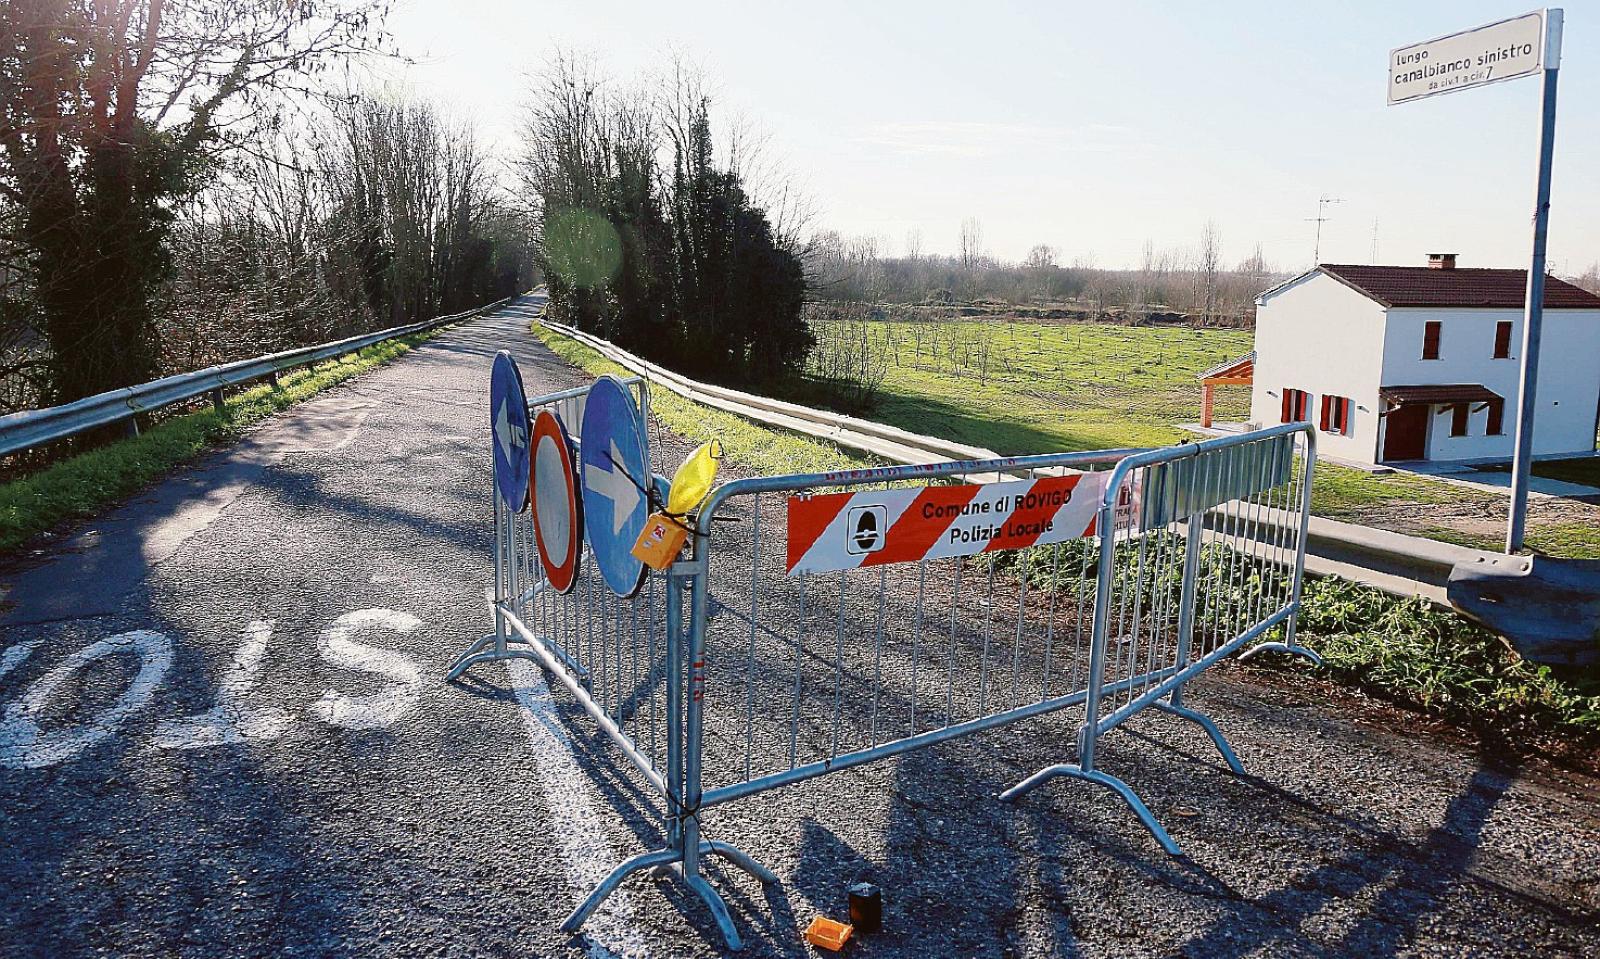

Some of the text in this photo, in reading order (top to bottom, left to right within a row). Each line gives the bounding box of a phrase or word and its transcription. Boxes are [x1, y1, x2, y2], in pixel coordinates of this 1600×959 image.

[1394, 43, 1532, 84] canalbianco sinistro
[1396, 50, 1429, 66] lungo
[922, 489, 1072, 519] Comune di ROVIGO
[950, 518, 1054, 545] Polizia Locale
